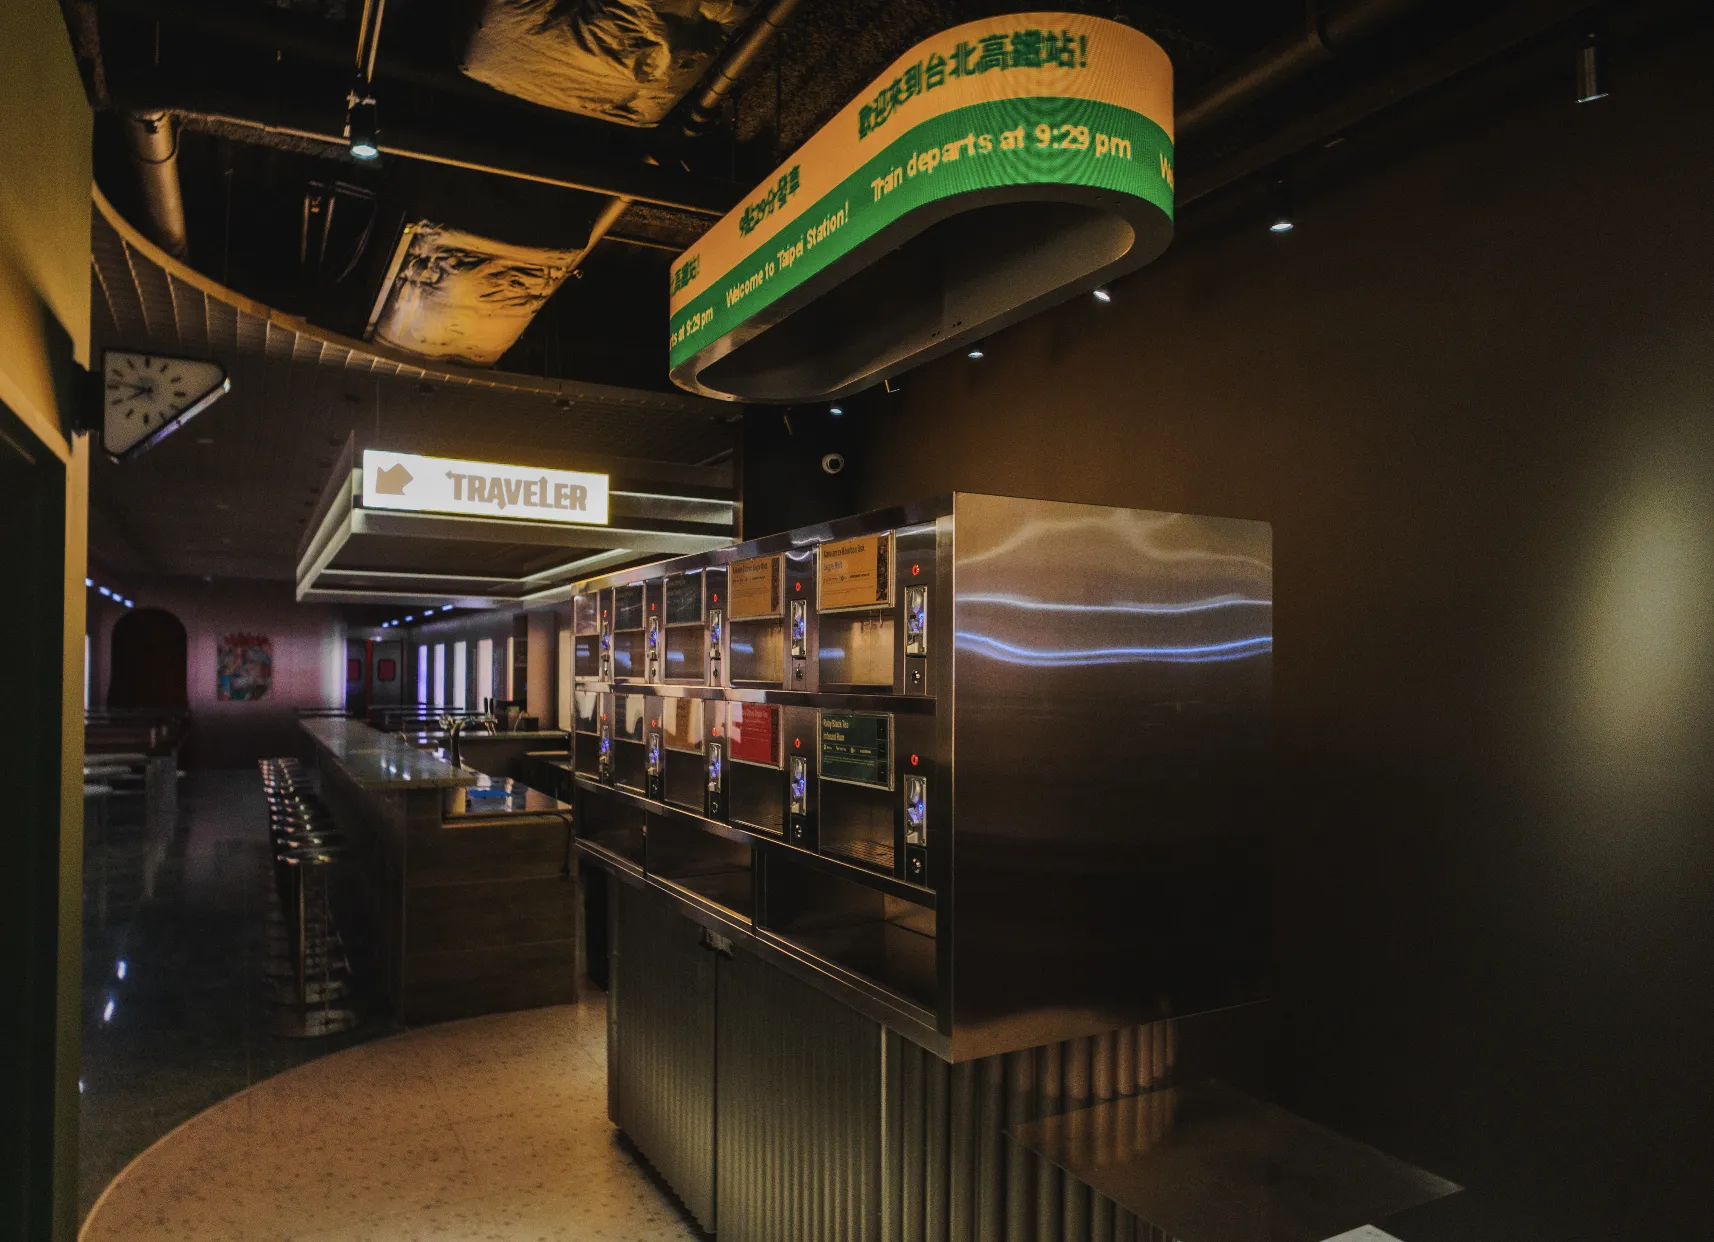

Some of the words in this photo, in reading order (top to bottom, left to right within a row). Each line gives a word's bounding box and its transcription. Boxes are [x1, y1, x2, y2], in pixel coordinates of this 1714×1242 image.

[870, 167, 903, 202] Train
[907, 131, 993, 172] departs
[1000, 126, 1026, 150] at
[1035, 124, 1090, 150] 9:29
[1095, 132, 1131, 159] pm
[725, 269, 763, 308] Welcome
[765, 261, 775, 280] to
[777, 236, 804, 271] Taipei
[807, 200, 849, 249] Station!
[686, 313, 701, 336] 9:29
[701, 306, 714, 330] pm
[445, 470, 588, 511] TRAVELER
